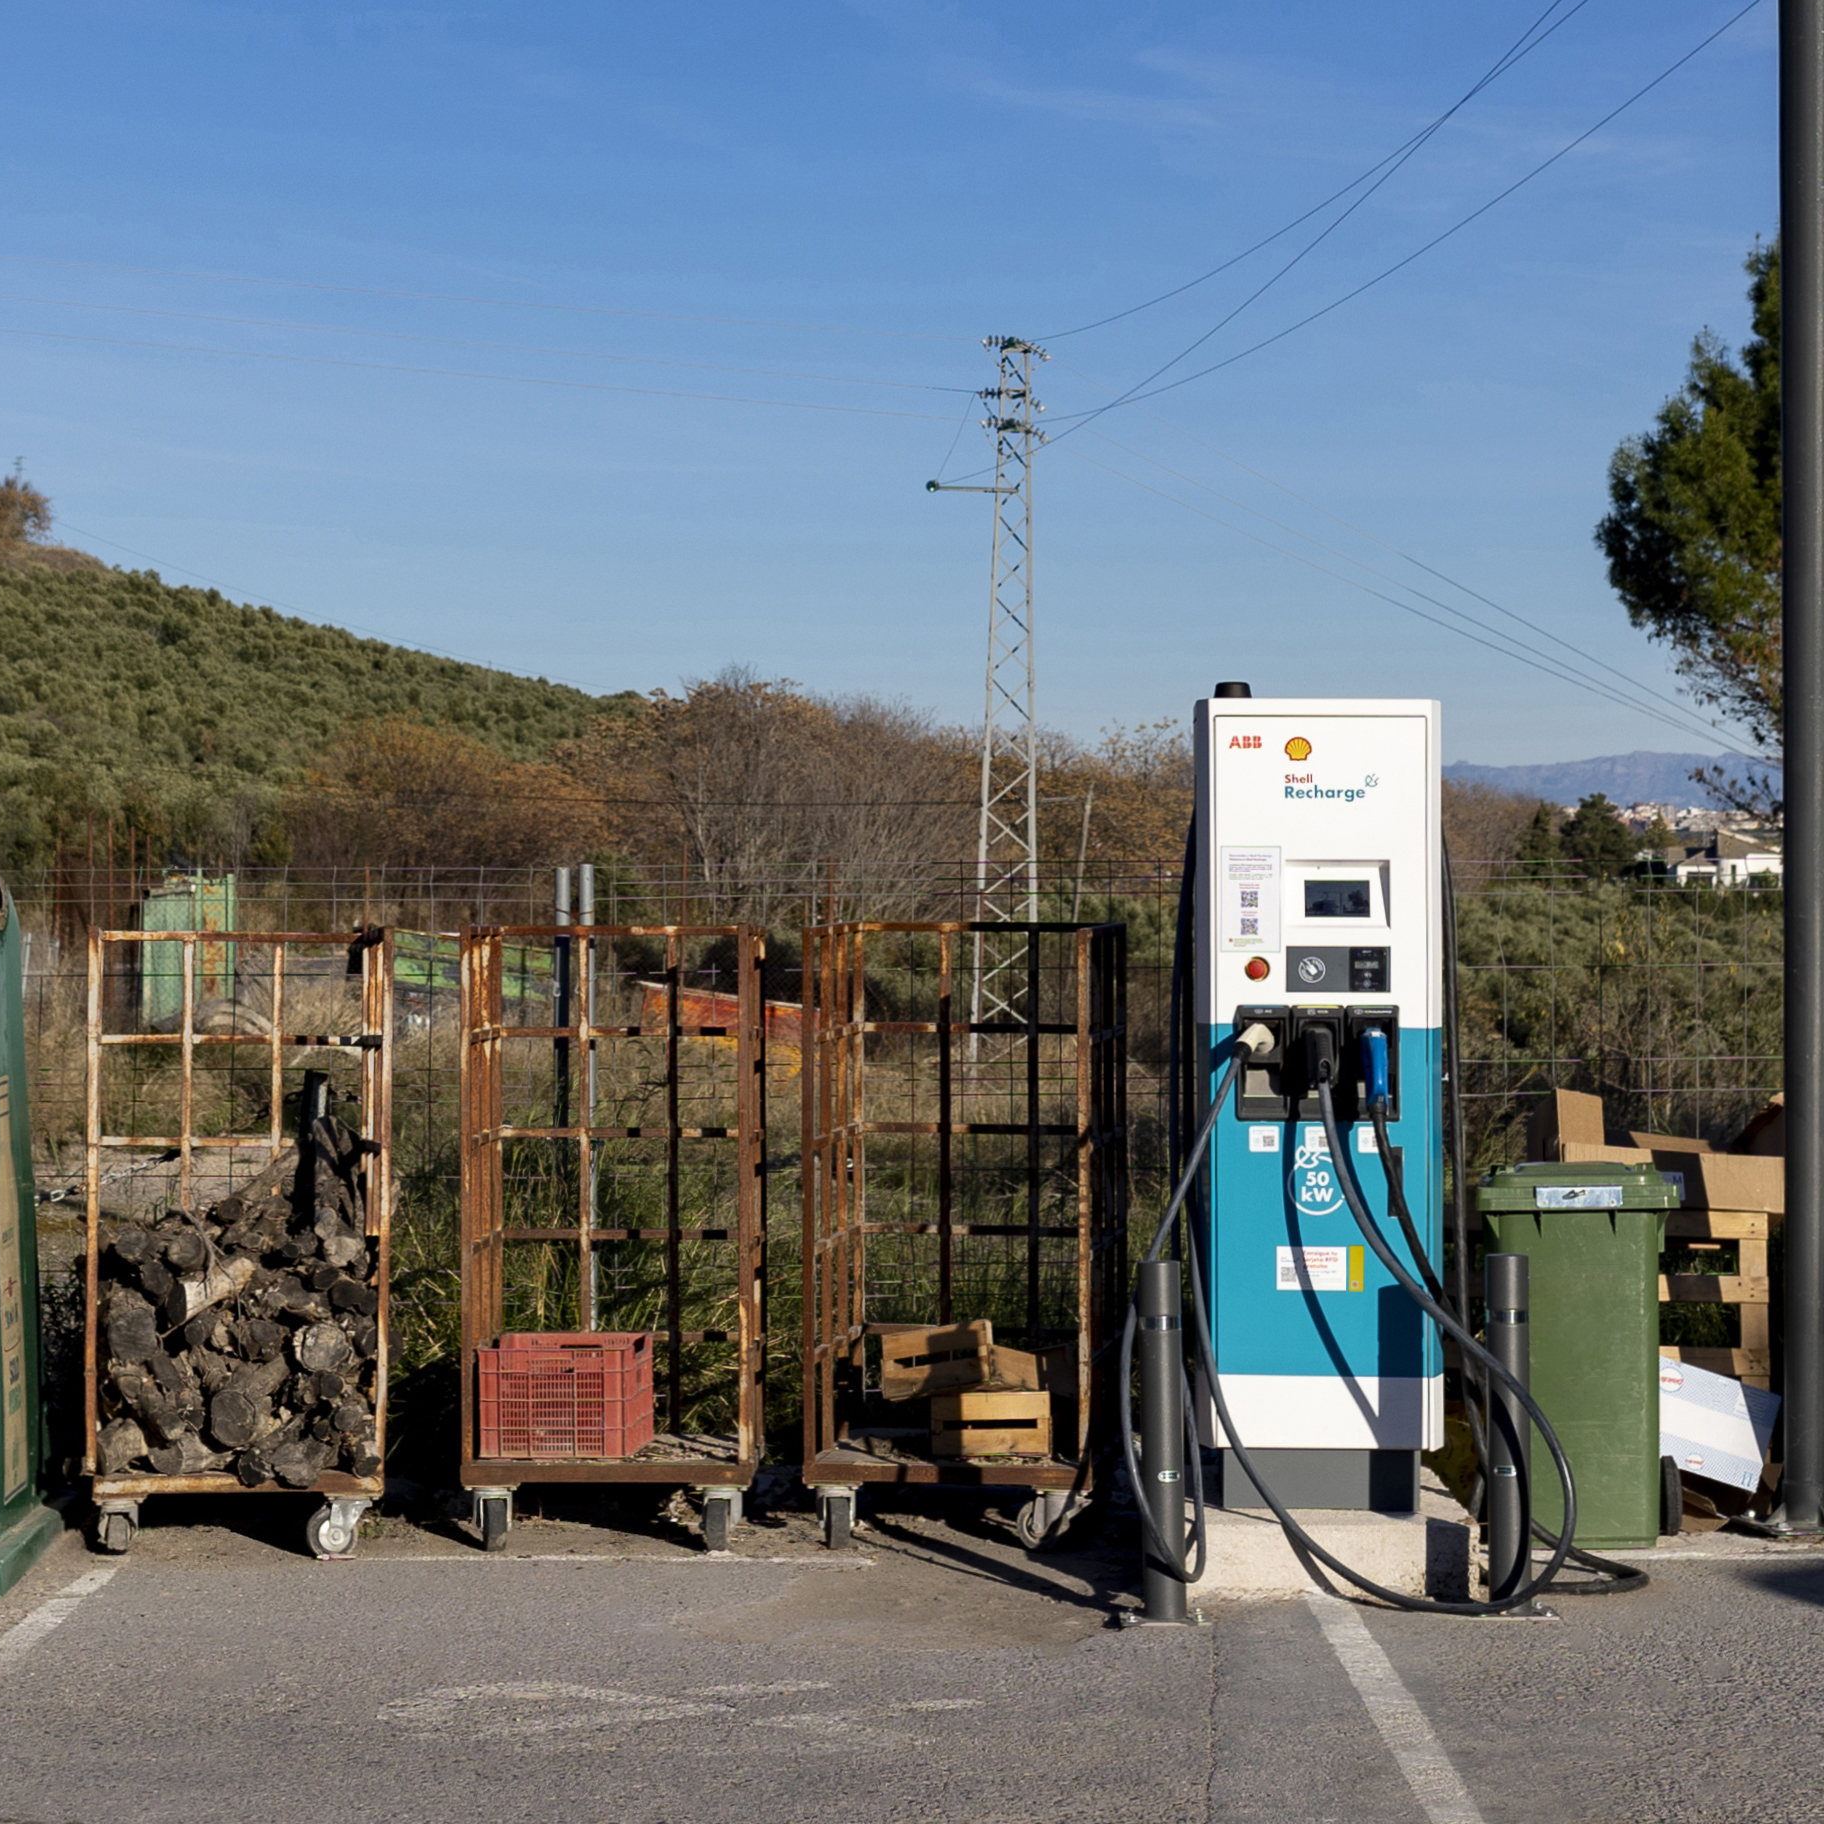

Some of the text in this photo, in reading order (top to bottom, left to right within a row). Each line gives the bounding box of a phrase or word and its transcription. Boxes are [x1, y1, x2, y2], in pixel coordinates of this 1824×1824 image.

[1229, 735, 1263, 749] ABB
[1284, 774, 1313, 784] Shell
[1284, 785, 1366, 803] Recharge
[1305, 1171, 1330, 1187] 50
[1301, 1185, 1334, 1203] kW
